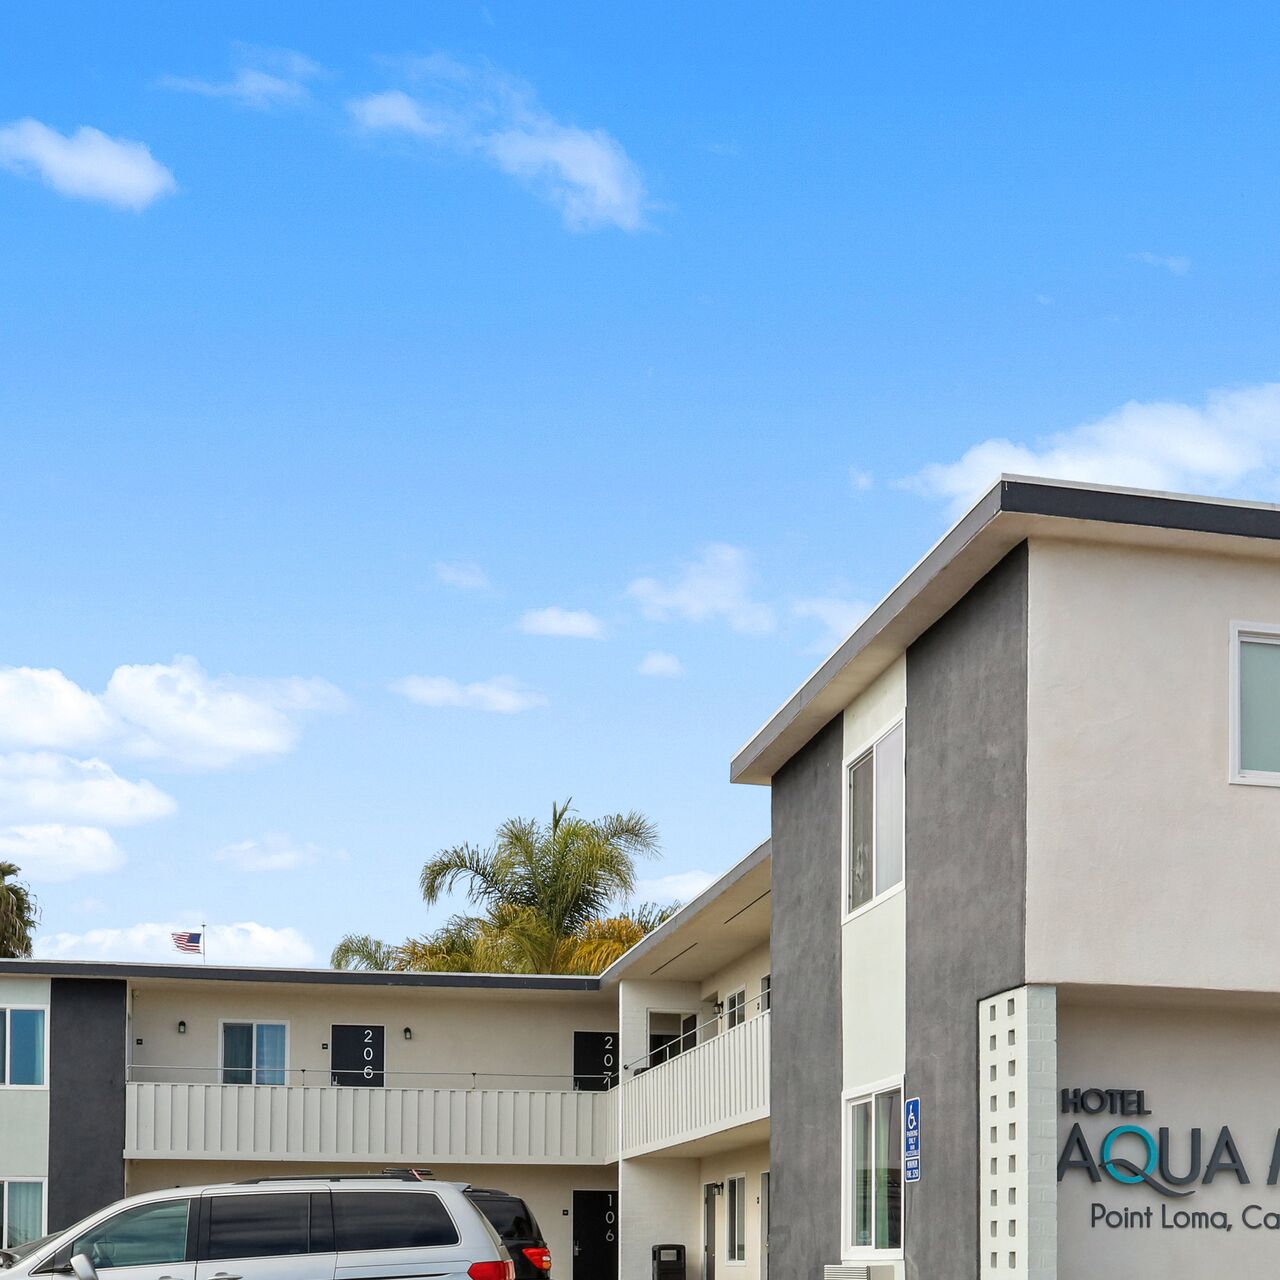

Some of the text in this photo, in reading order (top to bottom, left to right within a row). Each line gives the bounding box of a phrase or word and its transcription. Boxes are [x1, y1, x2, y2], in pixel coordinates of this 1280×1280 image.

[363, 1029, 374, 1080] 206
[603, 1036, 615, 1085] 207
[1060, 1088, 1153, 1116] HOTEL
[1056, 1122, 1251, 1197] AQUA
[605, 1194, 615, 1242] 106
[1091, 1203, 1154, 1229] Point
[1161, 1204, 1233, 1232] Loma,
